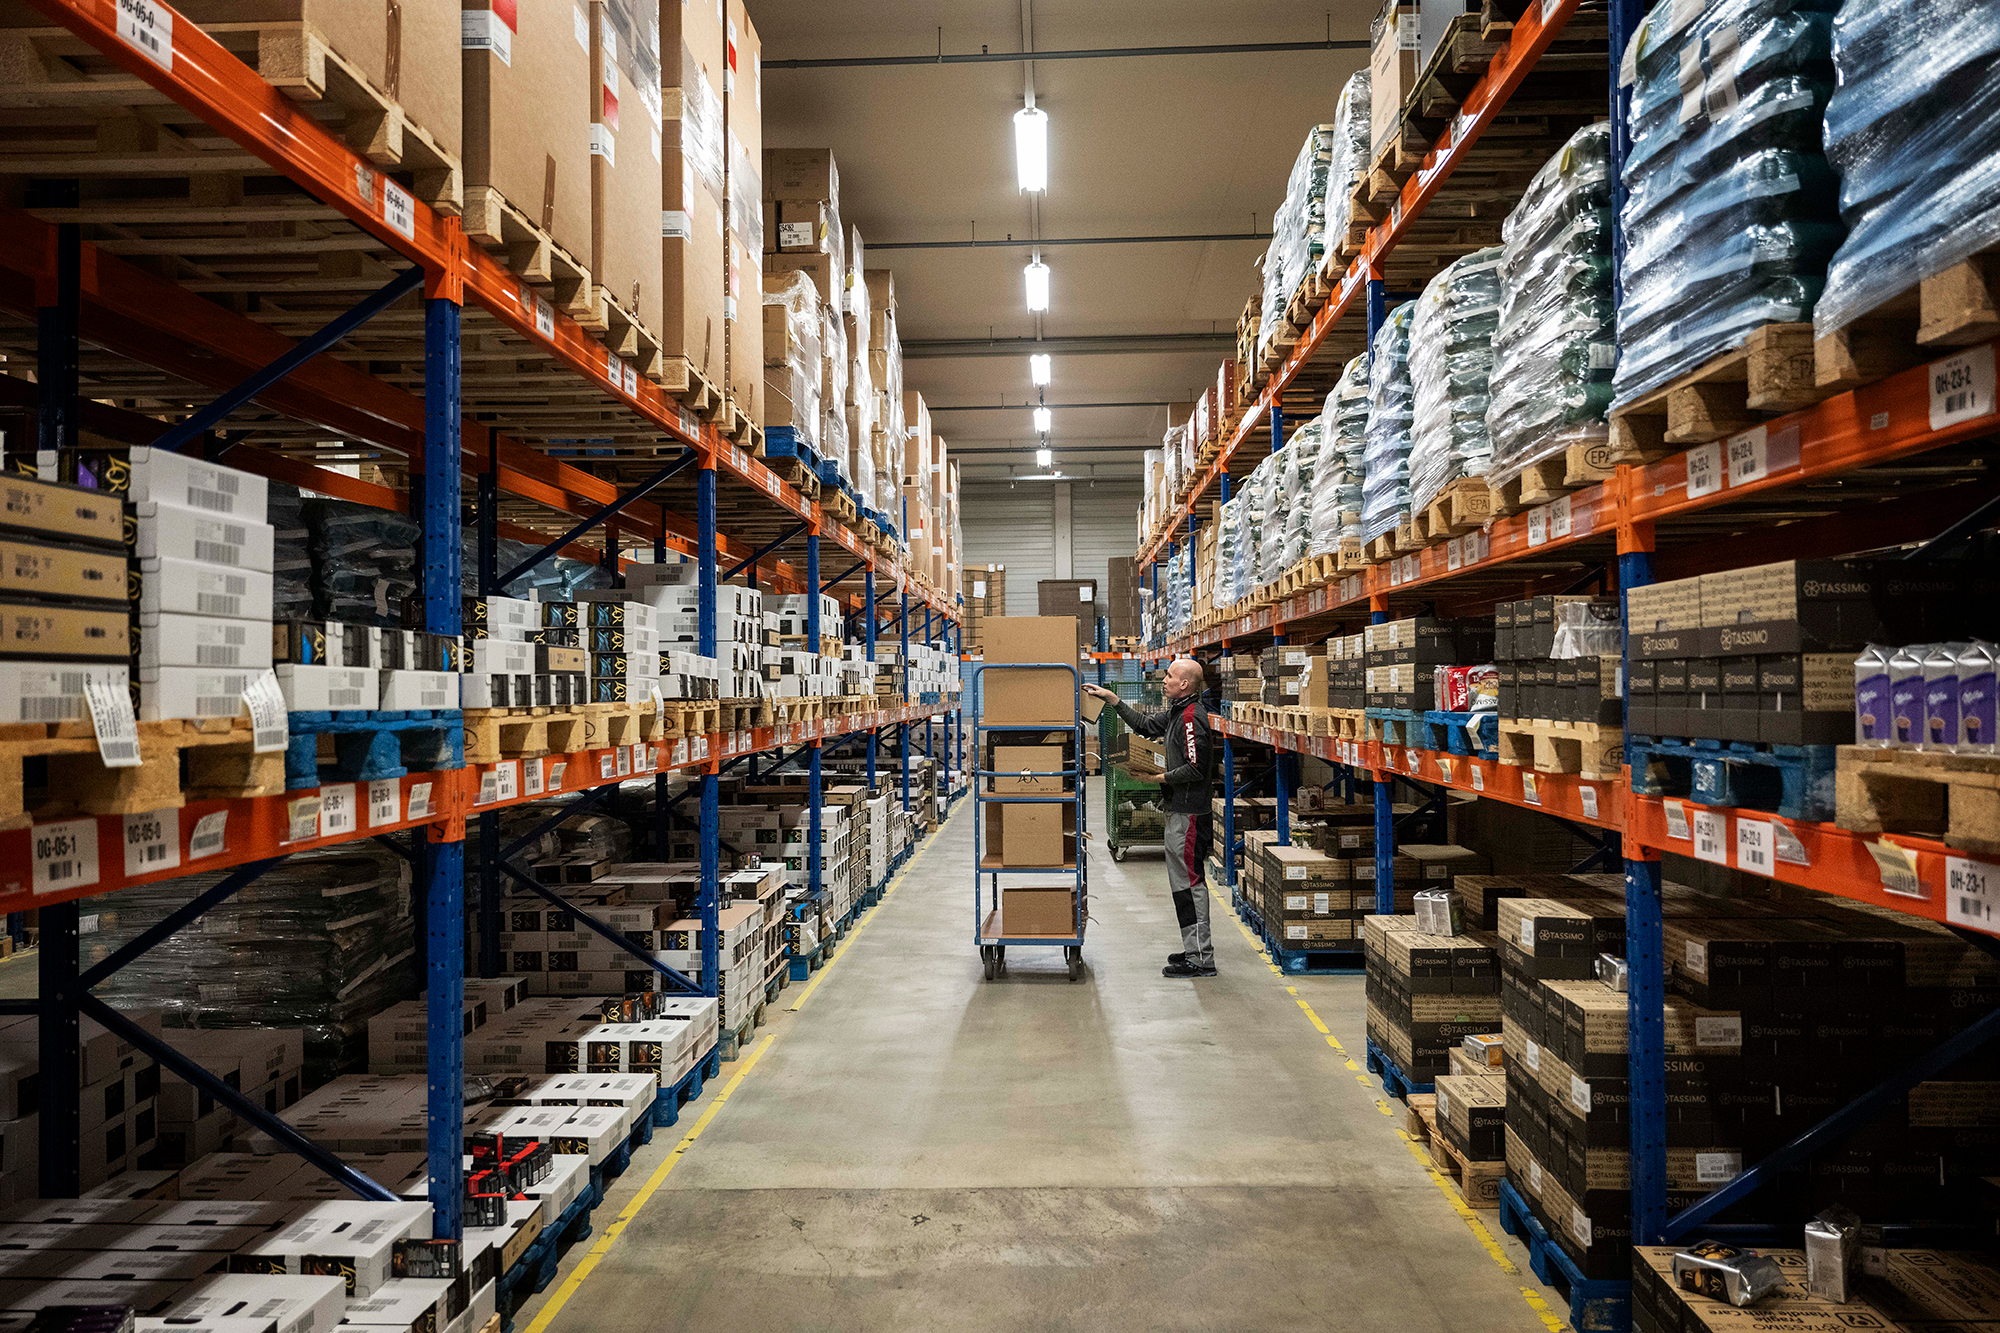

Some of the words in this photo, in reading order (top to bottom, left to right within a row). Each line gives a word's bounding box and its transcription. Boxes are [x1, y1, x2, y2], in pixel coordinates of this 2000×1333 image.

[1591, 452, 1610, 464] EPA
[1470, 499, 1490, 509] EPA
[1820, 582, 1871, 594] TASSIMO
[1730, 629, 1769, 645] TASSIMO
[1650, 637, 1680, 651] TASSIMO
[1549, 932, 1585, 940] TASSIMO
[1465, 957, 1490, 965] TASSIMO
[1725, 957, 1765, 966] TASSIMO
[1789, 958, 1829, 967] TASSIMO
[1854, 958, 1894, 967] TASSIMO
[1969, 993, 2000, 1003] TASS
[1451, 1026, 1490, 1034] TASSIMO
[1762, 1027, 1801, 1036] TASSIMO
[1829, 1027, 1868, 1036] TASSIMO
[1664, 1062, 1705, 1072] SSIMO
[1604, 1095, 1629, 1103] TASSI
[1668, 1094, 1707, 1103] TASSIMO
[1732, 1095, 1770, 1103] TASSIMO
[1831, 1165, 1870, 1174] TASSIMO
[1897, 1165, 1936, 1174] TASSIMO
[1482, 1184, 1500, 1195] EPA
[1606, 1229, 1631, 1238] TASSI
